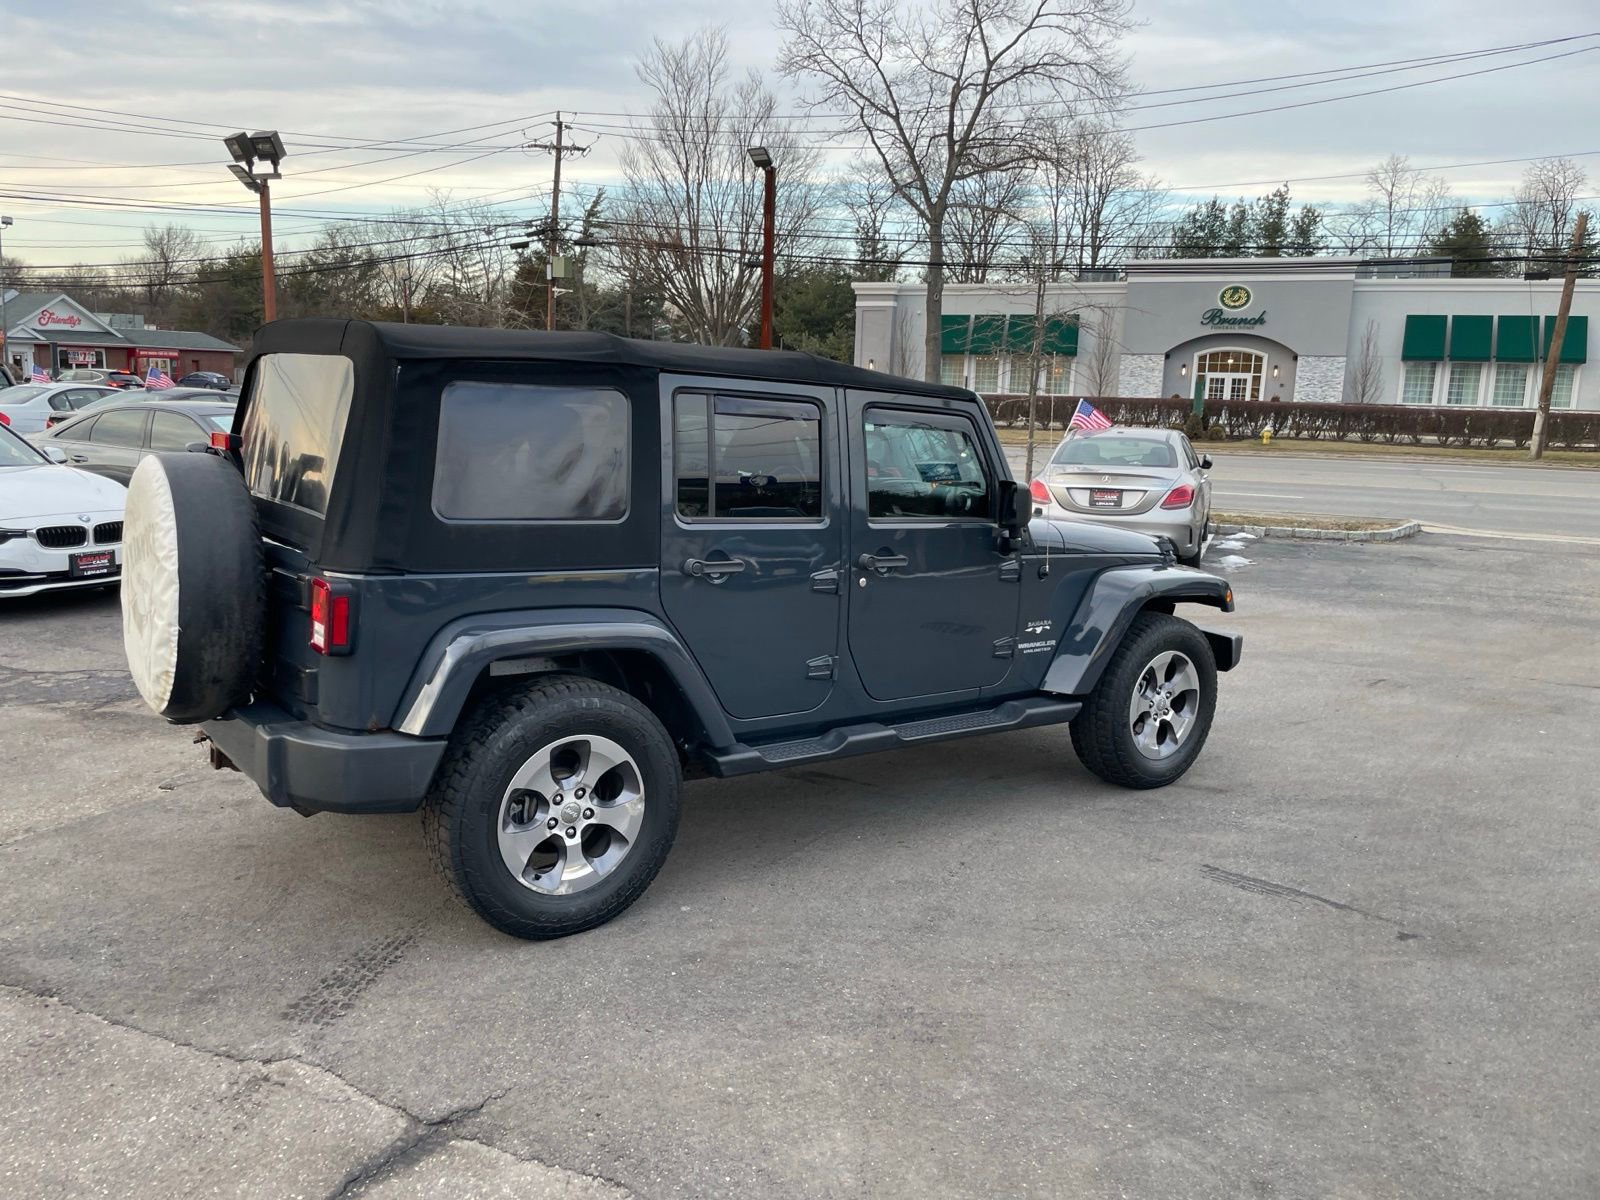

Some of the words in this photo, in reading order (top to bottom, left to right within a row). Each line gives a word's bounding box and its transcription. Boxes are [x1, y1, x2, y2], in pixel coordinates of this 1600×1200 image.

[38, 309, 82, 328] Friendly's
[1200, 308, 1267, 326] Branch
[1018, 640, 1056, 649] WRANGLER
